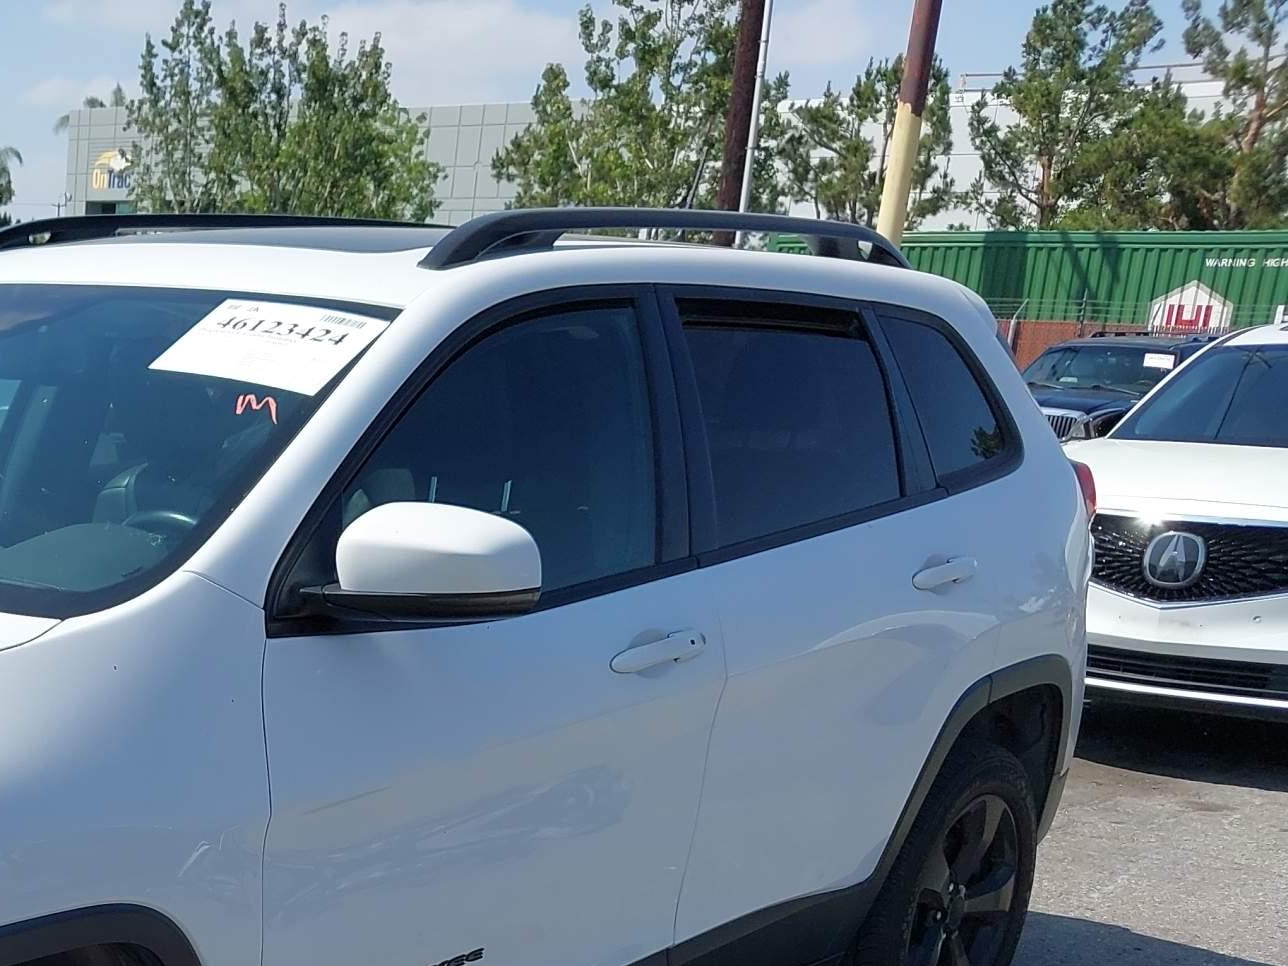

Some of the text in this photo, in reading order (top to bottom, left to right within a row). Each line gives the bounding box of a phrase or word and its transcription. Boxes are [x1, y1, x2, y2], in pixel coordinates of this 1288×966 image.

[1205, 257, 1288, 268] WARNING HIGH
[216, 314, 350, 347] 46123424
